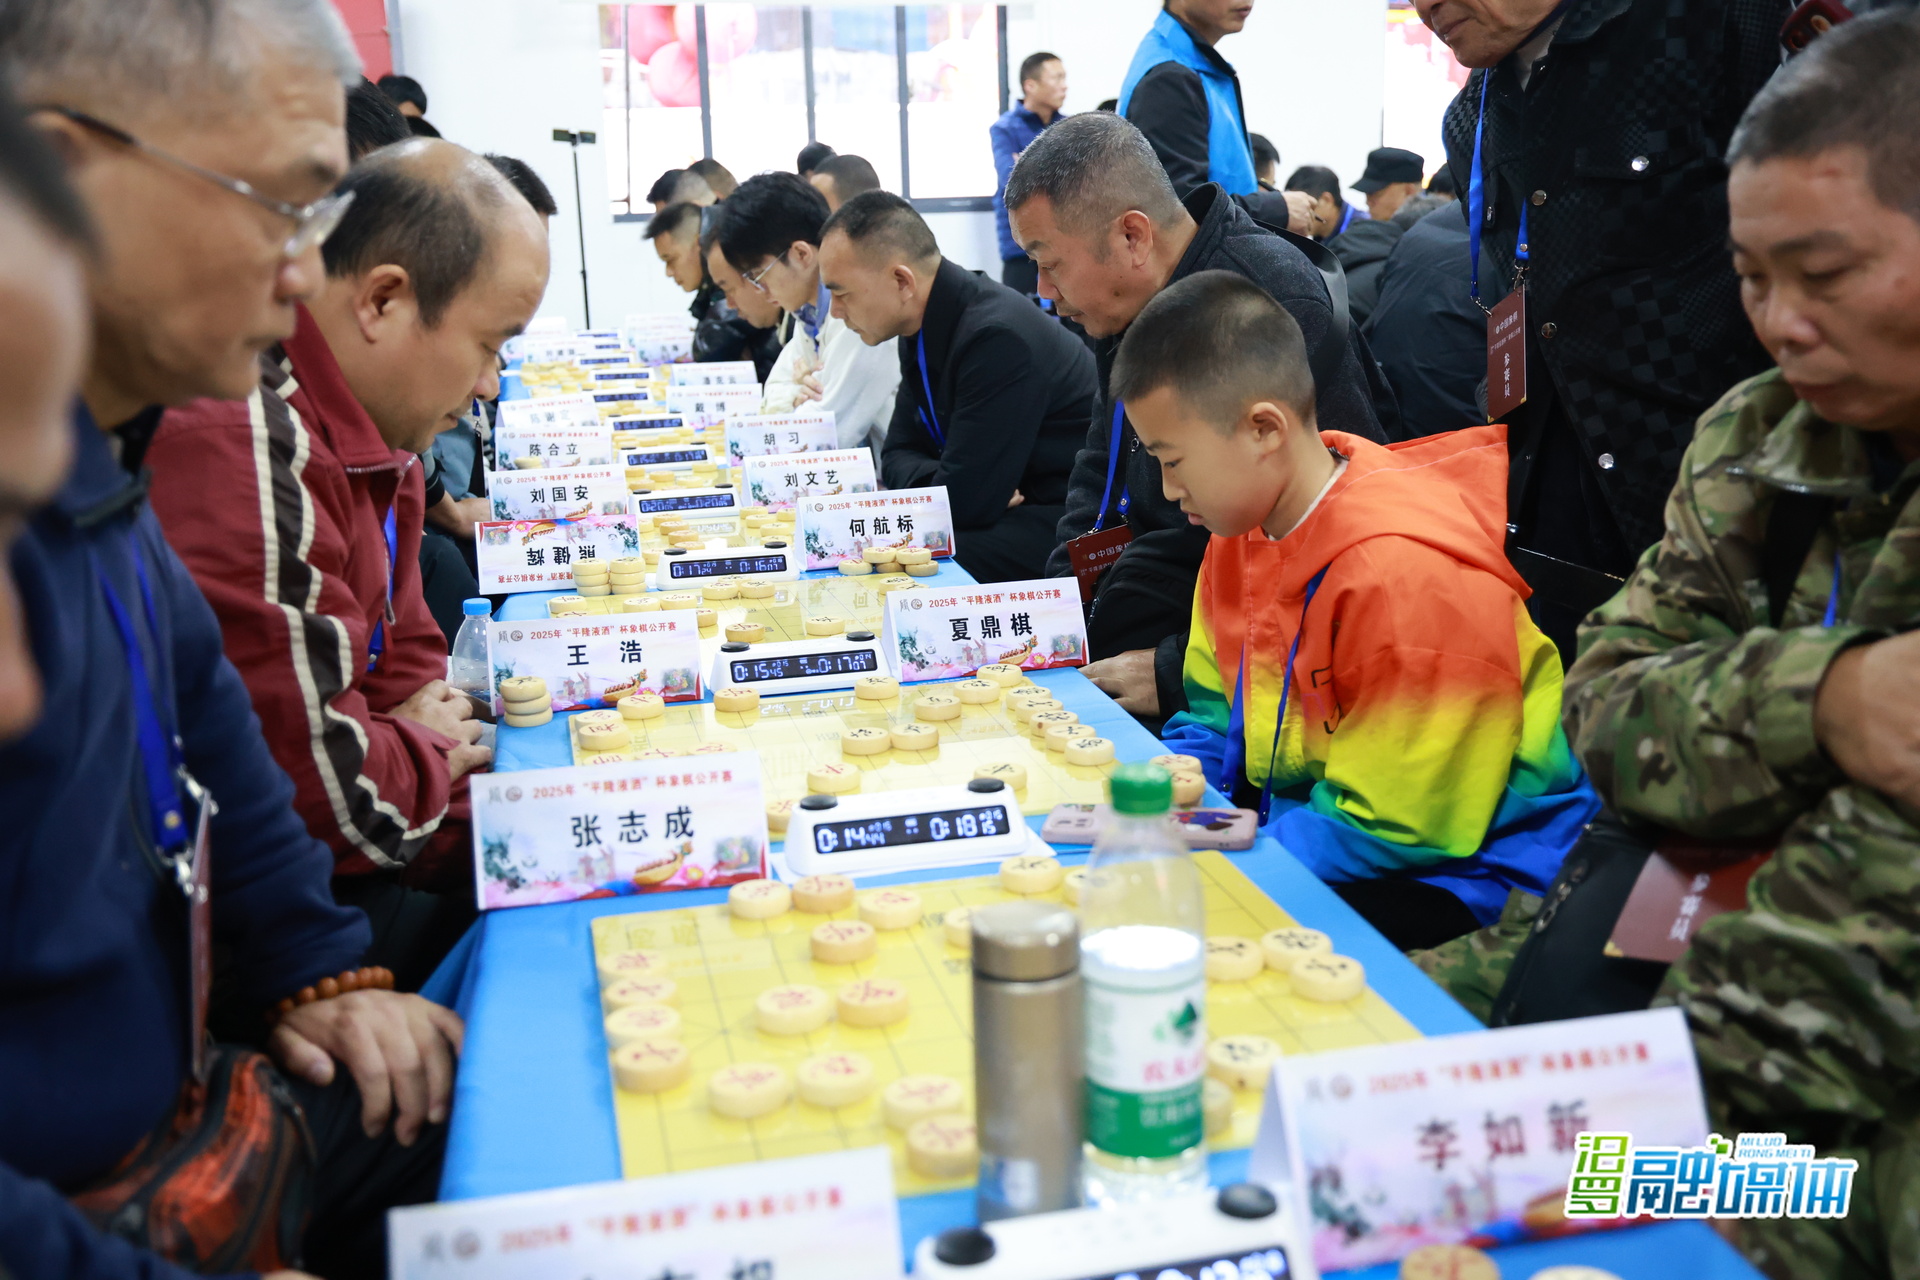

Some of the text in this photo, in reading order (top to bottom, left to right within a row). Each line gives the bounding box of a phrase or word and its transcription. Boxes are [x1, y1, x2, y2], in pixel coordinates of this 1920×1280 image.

[764, 432, 799, 445] 胡习
[529, 443, 578, 456] 陈合立
[784, 470, 839, 488] 刘文艺
[530, 485, 589, 504] 刘国安
[828, 496, 932, 510] 2025年“平隆液酒”杯象棋公开赛
[849, 514, 914, 538] 何航标
[929, 588, 1062, 608] 2025年“平隆液酒”杯象棋公开赛
[530, 622, 677, 640] 2025年“平隆液酒”杯象棋公开赛
[949, 612, 1033, 642] 夏鼎棋
[567, 640, 642, 666] 王浩
[571, 805, 694, 848] 张志成
